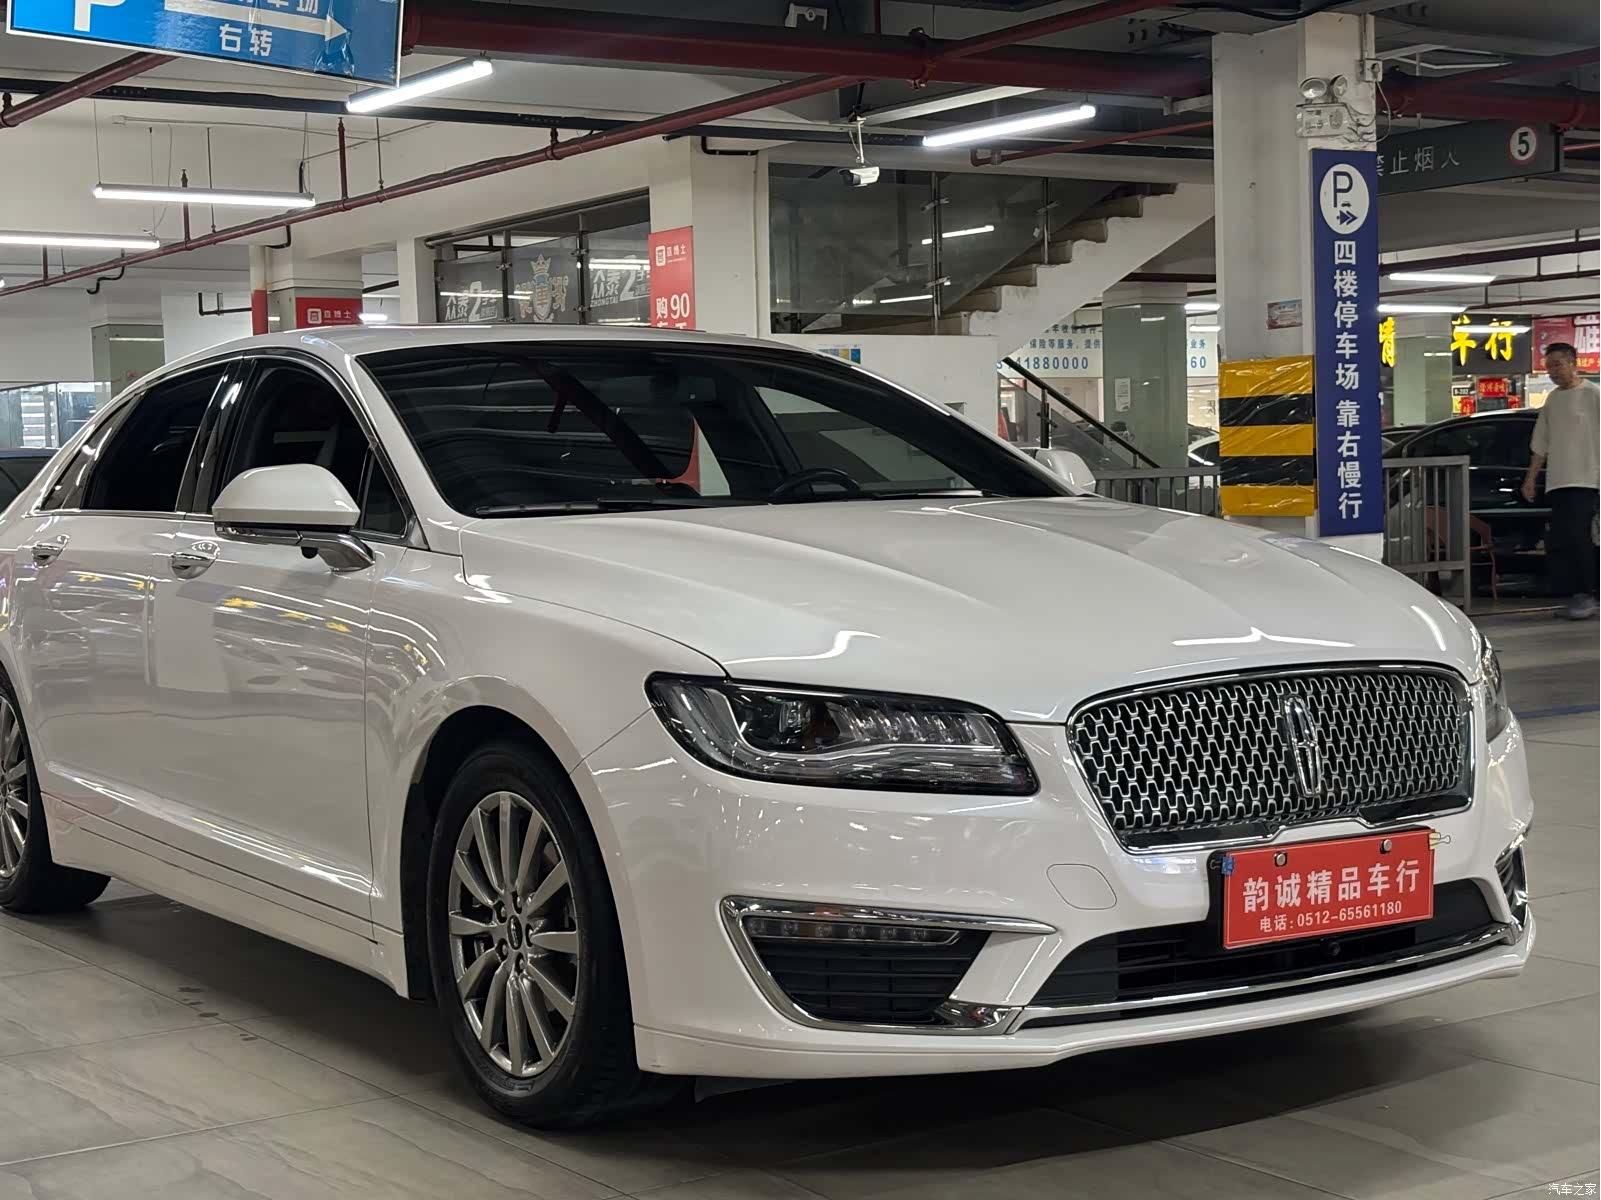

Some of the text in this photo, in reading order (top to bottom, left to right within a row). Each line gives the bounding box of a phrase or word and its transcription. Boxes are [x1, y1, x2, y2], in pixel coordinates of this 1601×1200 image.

[219, 23, 273, 57] 右转
[1516, 134, 1531, 157] 5
[1333, 171, 1354, 208] P
[670, 292, 690, 319] 90
[1190, 338, 1207, 350] 业务
[1190, 355, 1207, 369] 60
[1333, 240, 1363, 520] 四楼停车场 靠右慢行
[1243, 859, 1420, 914] 韵诚精品车行
